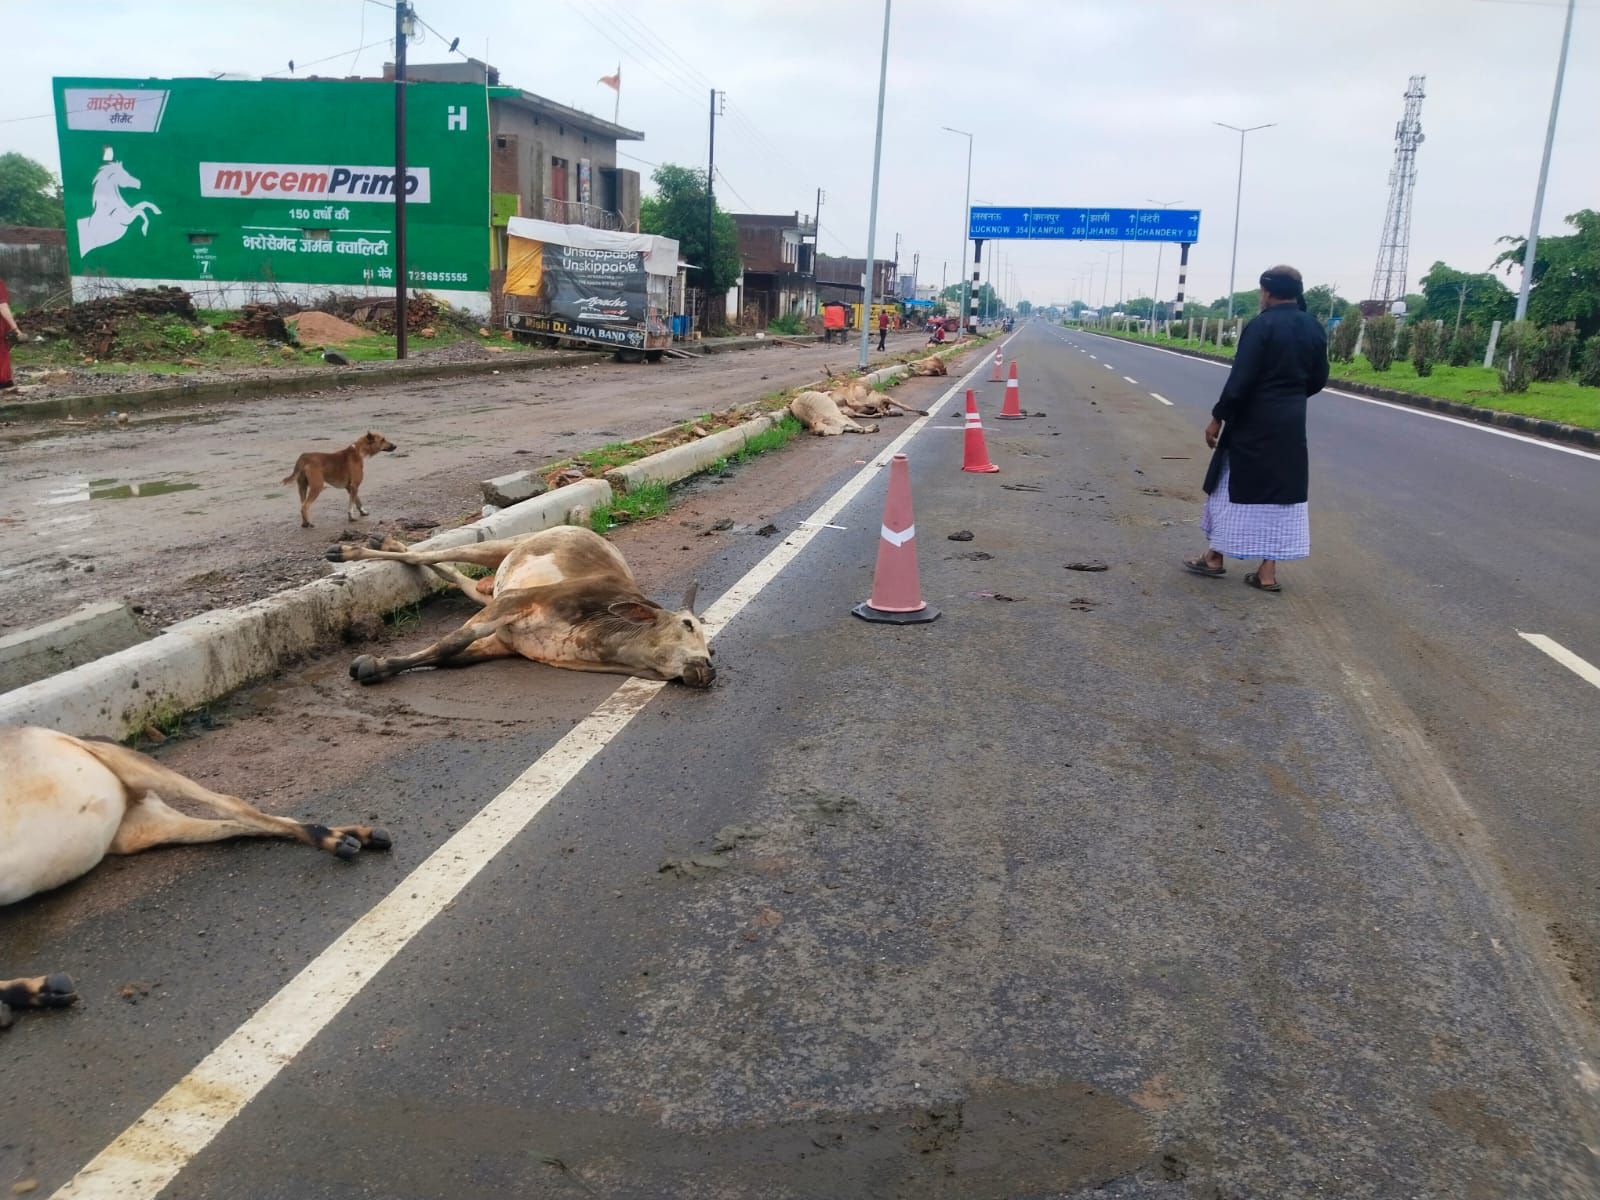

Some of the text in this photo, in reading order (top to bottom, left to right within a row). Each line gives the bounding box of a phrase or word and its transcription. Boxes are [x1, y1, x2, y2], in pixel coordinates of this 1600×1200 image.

[87, 94, 136, 111] माईसेम
[289, 208, 310, 220] 150
[334, 207, 350, 220] की
[971, 225, 1028, 234] LUCKNOW 354
[1032, 226, 1064, 234] KANPUR
[1089, 228, 1134, 236] JHANSI 55
[1138, 228, 1183, 237] CHANDERY
[336, 238, 388, 255] क्वालिटी
[553, 321, 567, 333] DJ
[574, 324, 596, 338] JIYA
[598, 329, 625, 341] BAND
